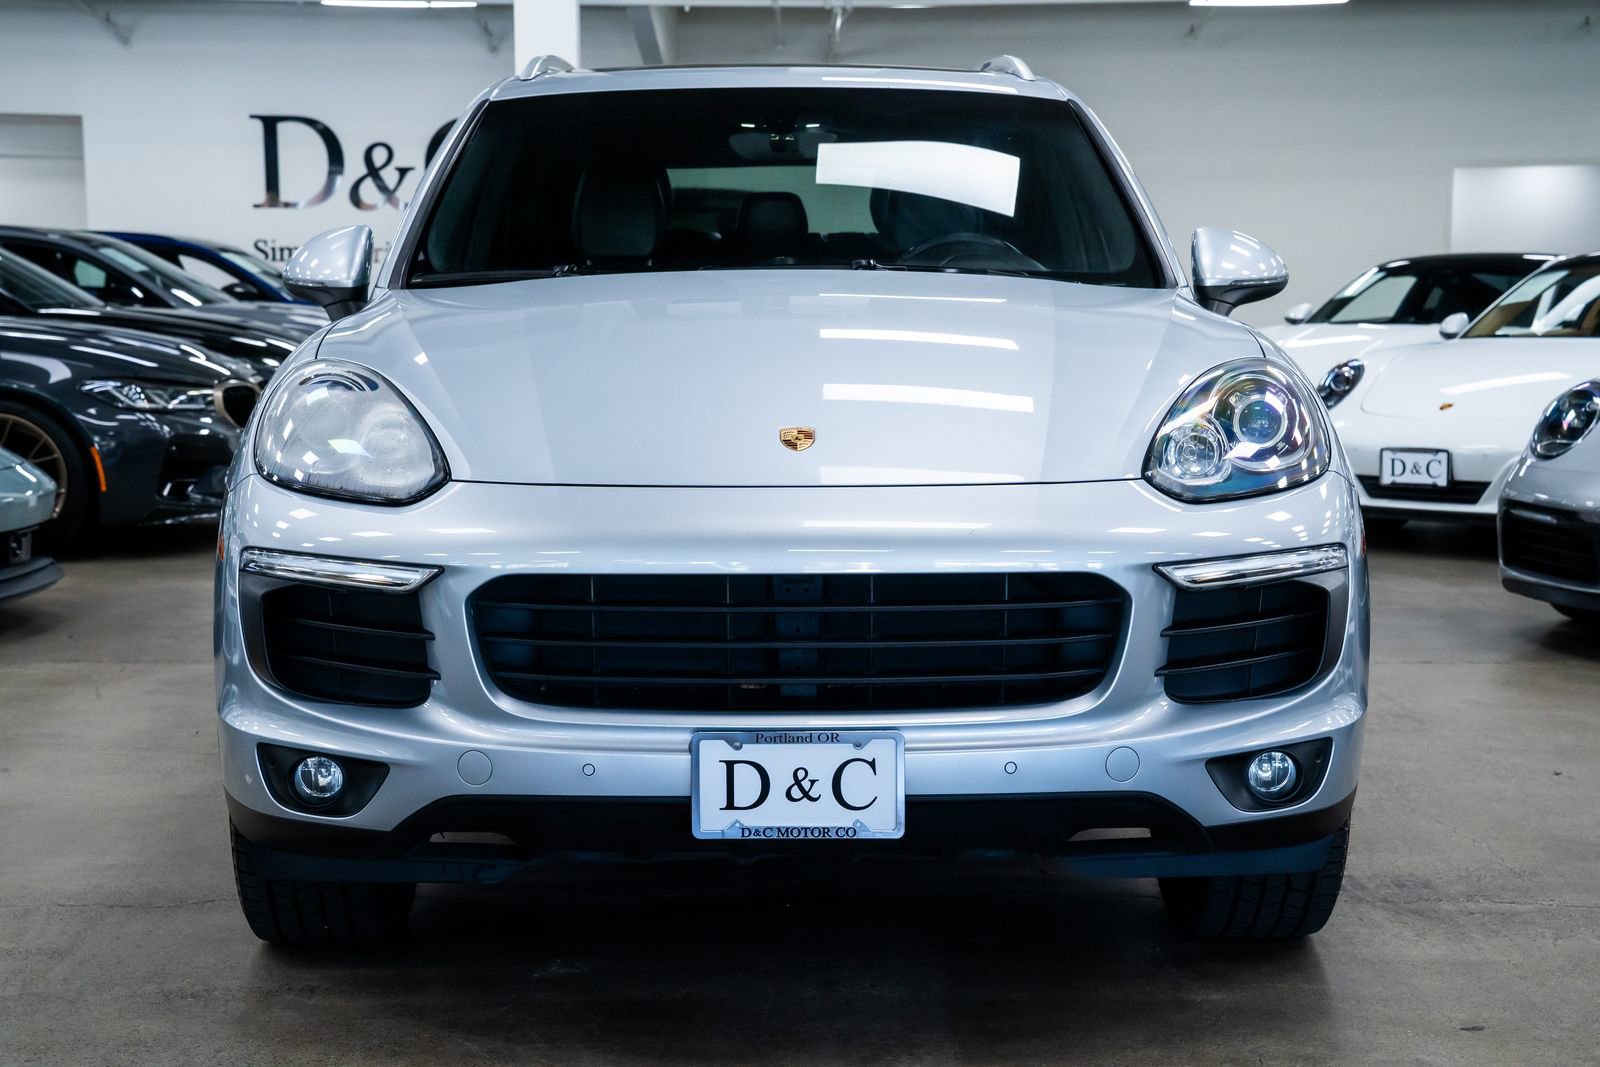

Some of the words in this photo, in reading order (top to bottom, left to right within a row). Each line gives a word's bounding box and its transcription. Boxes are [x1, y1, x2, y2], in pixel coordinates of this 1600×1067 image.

[249, 114, 458, 210] D&
[755, 732, 813, 744] Portland
[817, 732, 841, 743] OR
[740, 827, 773, 838] D&C
[776, 827, 832, 838] MOTOR
[835, 827, 857, 838] CO
